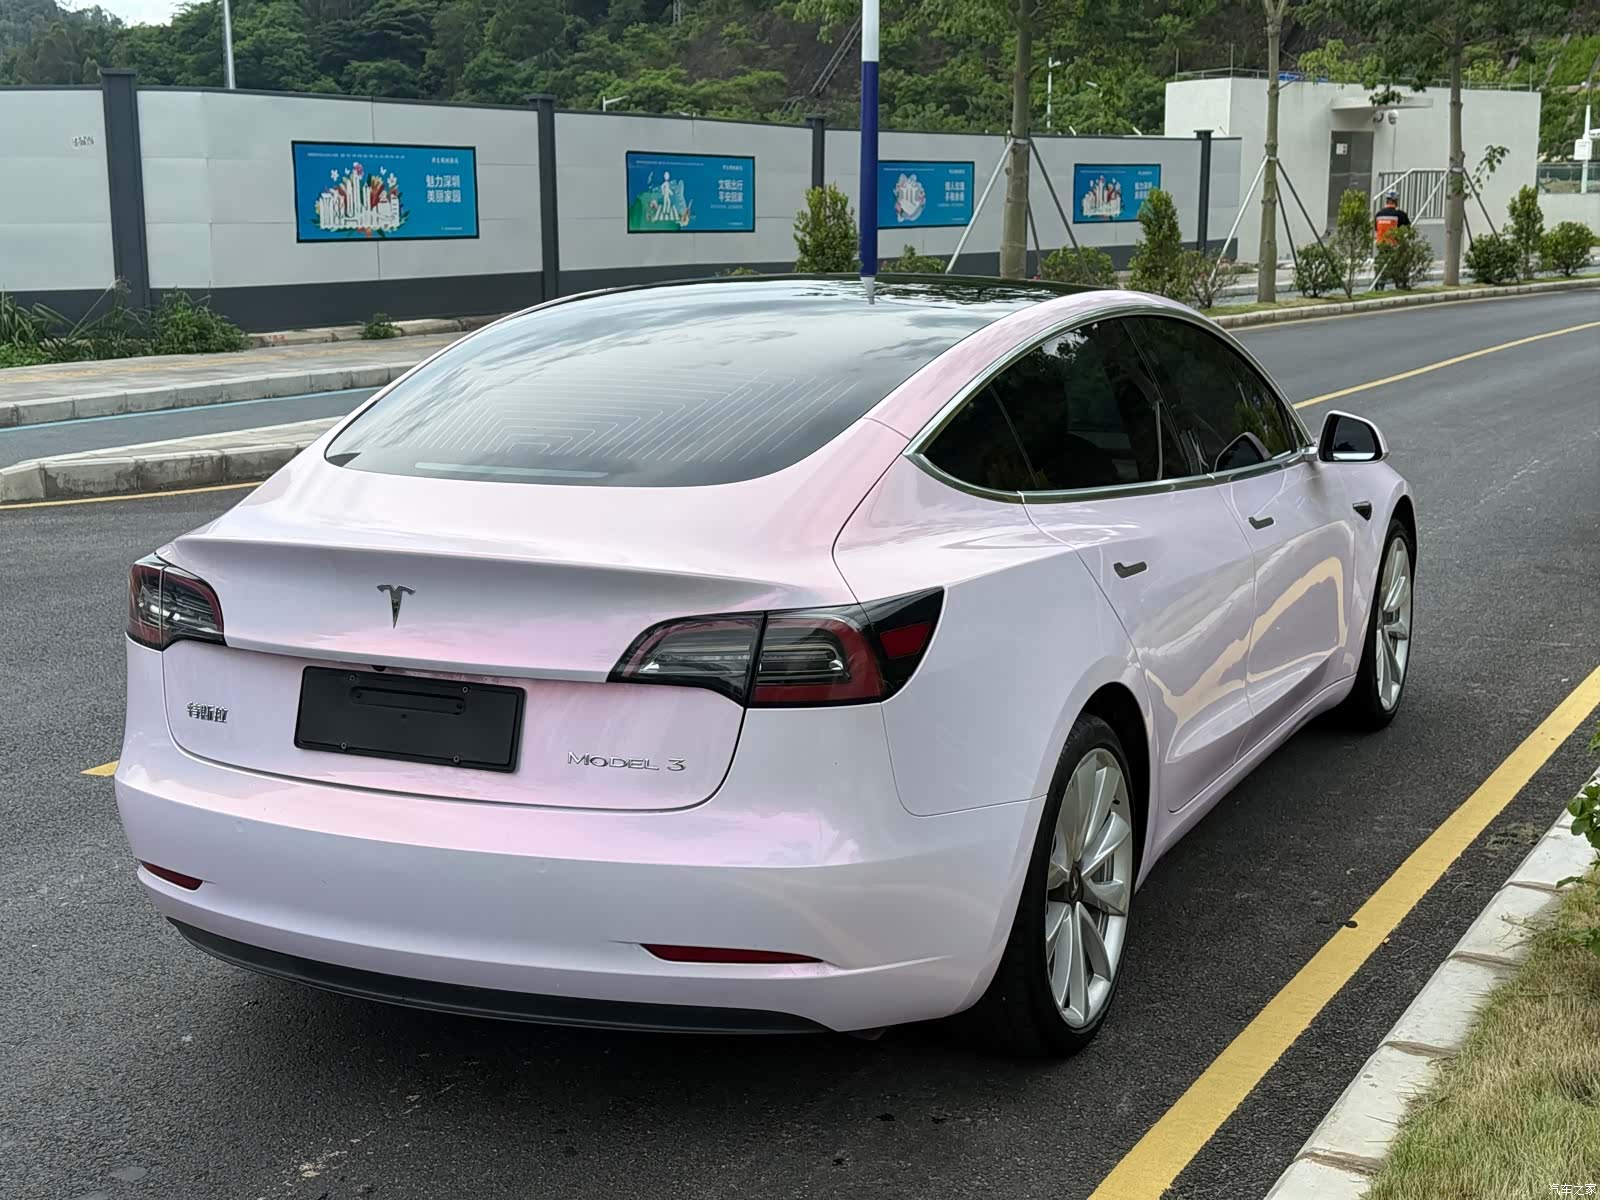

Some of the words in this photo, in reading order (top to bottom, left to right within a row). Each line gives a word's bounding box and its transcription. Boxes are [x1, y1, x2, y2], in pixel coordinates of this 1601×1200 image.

[426, 174, 461, 188] 魅力深圳
[718, 179, 744, 191] 文明出行
[427, 189, 462, 203] 美丽家园
[187, 701, 229, 724] 特斯拉
[568, 751, 660, 771] MODEL
[666, 758, 687, 772] 3
